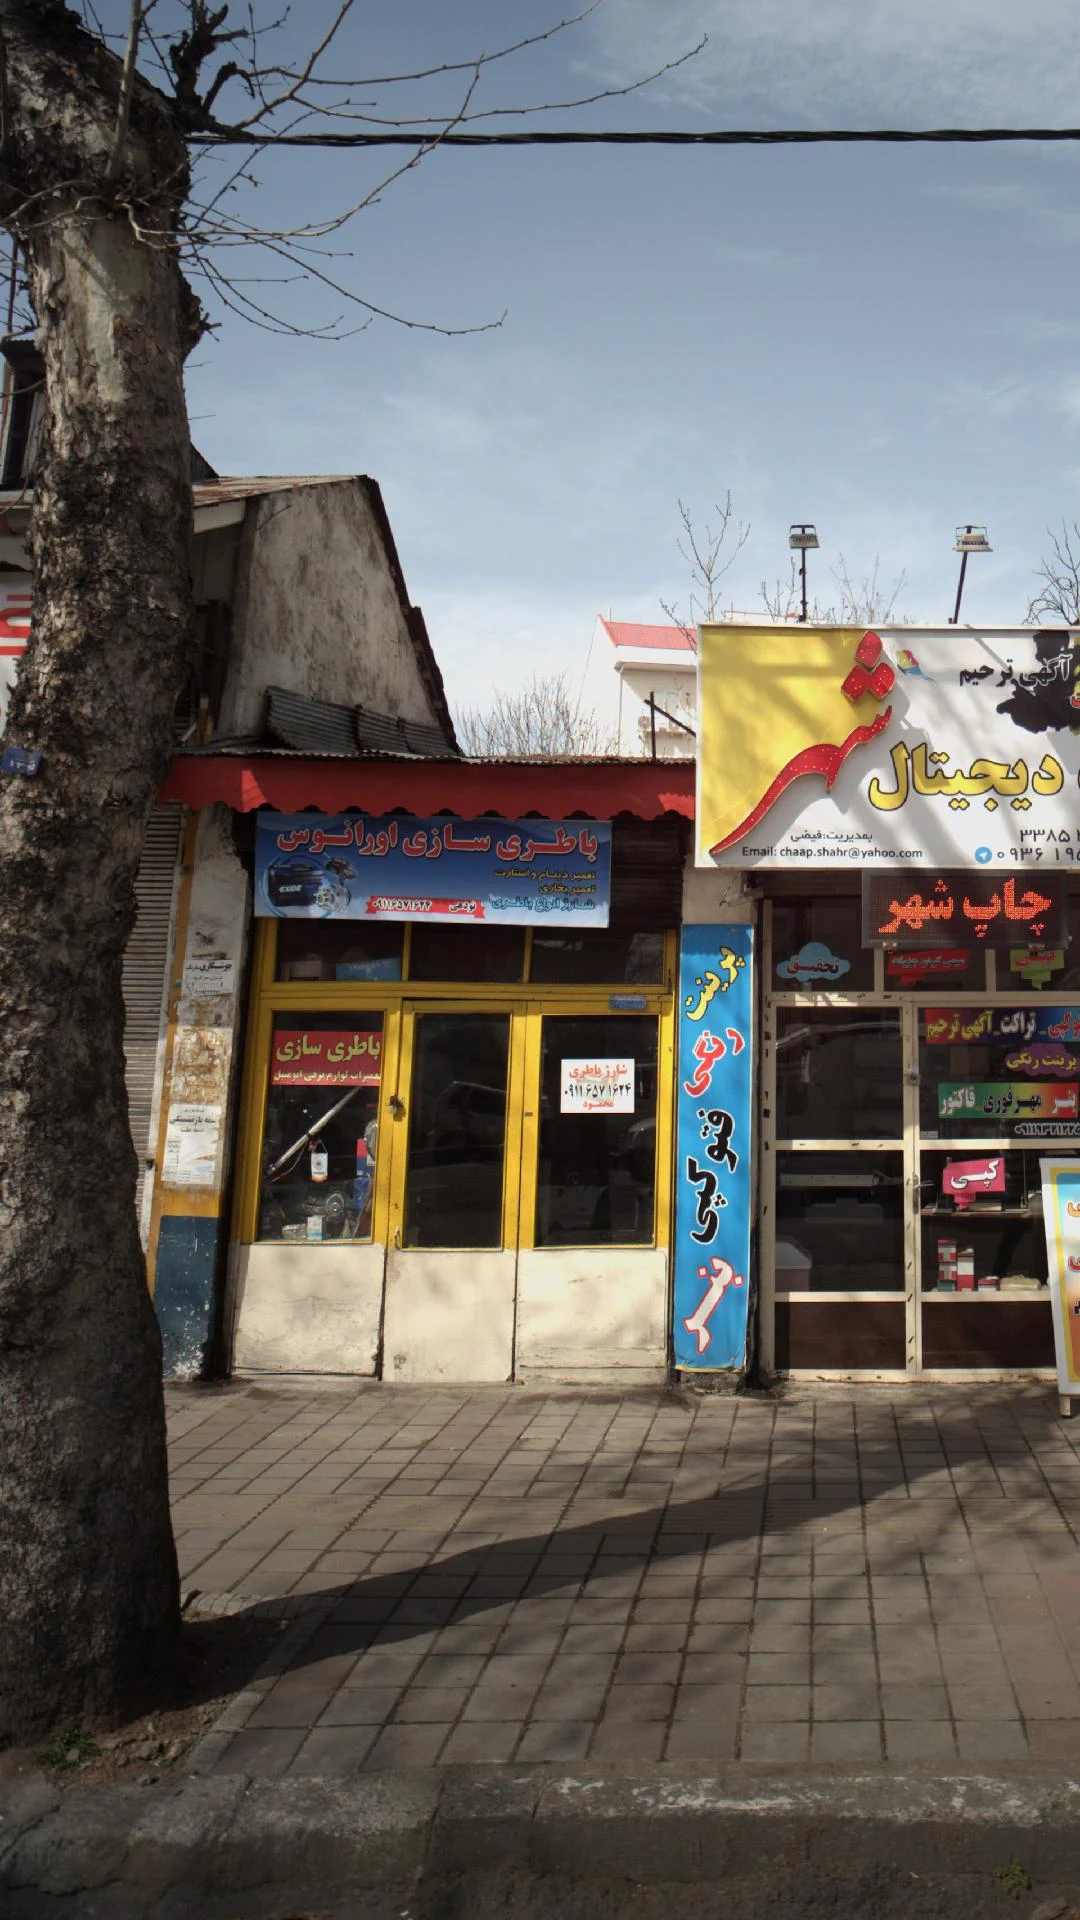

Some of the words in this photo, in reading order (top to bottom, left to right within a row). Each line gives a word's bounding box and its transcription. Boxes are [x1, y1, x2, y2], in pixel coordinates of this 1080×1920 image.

[959, 658, 1013, 687] ترحیم
[1019, 653, 1073, 687] آگهی
[868, 740, 1064, 812] دیجیتال
[277, 820, 398, 857] اورانوس
[402, 824, 490, 858] سازی
[496, 827, 598, 862] باطری
[742, 846, 777, 857] Email:
[779, 846, 922, 859] chaap.shahr@yahoo.com
[878, 879, 954, 934] شهر
[963, 877, 1052, 938] چاپ
[786, 958, 840, 976] تحقیق
[684, 946, 746, 1022] پرینت
[927, 1013, 960, 1039] ترحیم
[961, 1008, 994, 1039] آگهی
[1000, 1010, 1036, 1040] تراکت
[276, 1034, 322, 1062] سازی
[327, 1034, 380, 1062] باطری
[684, 1027, 745, 1098] رنگی
[1007, 1052, 1039, 1069] رنگی
[1042, 1054, 1077, 1070] پرینت
[569, 1064, 602, 1078] باطری
[939, 1086, 975, 1114] فاکتور
[951, 1159, 1000, 1188] کپی
[682, 1256, 744, 1354] بنر
